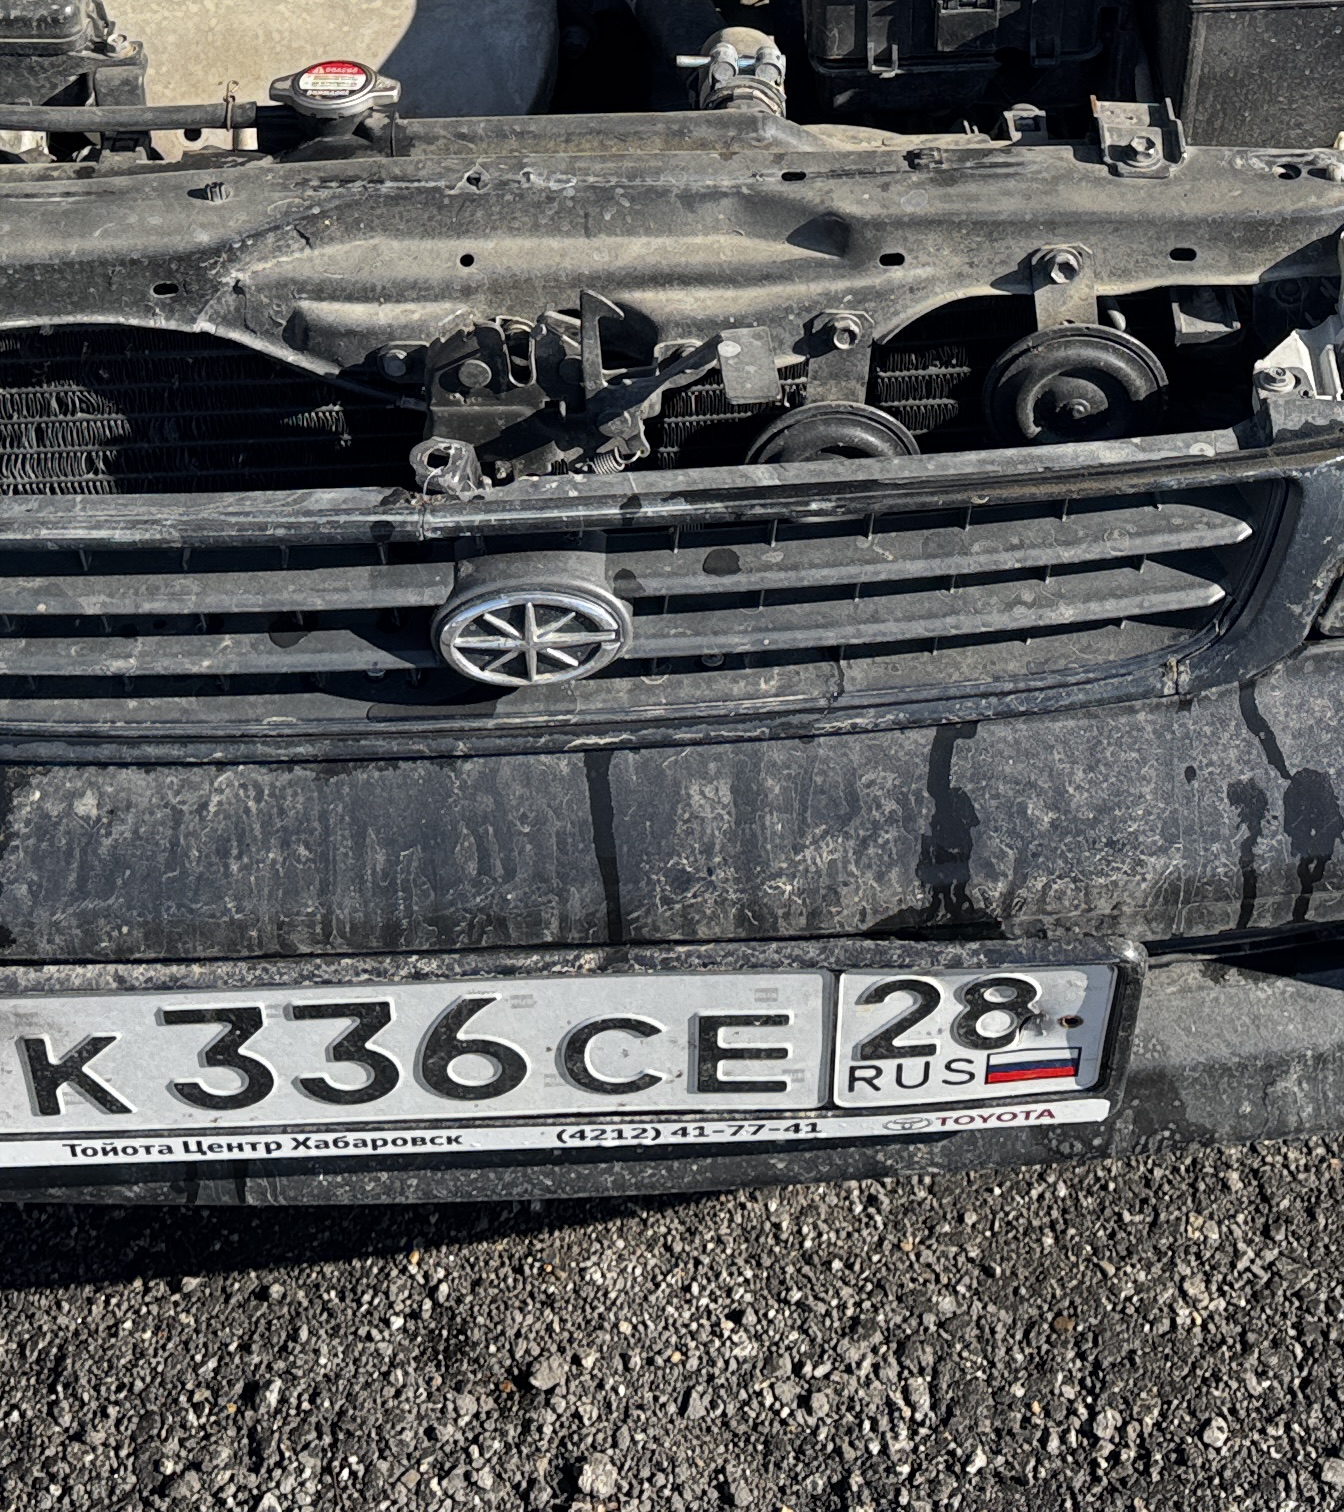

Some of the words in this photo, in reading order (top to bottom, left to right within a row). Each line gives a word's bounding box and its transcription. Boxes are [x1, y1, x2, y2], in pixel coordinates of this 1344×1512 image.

[854, 976, 1037, 1061] 28
[847, 1059, 977, 1094] RUS
[934, 1108, 1057, 1128] TOYOTA
[555, 1124, 662, 1144] (4212)
[671, 1121, 823, 1139] 41-77-41
[62, 1141, 174, 1159] Тойота
[182, 1138, 282, 1156] Центр
[290, 1134, 464, 1151] Хабаровск
